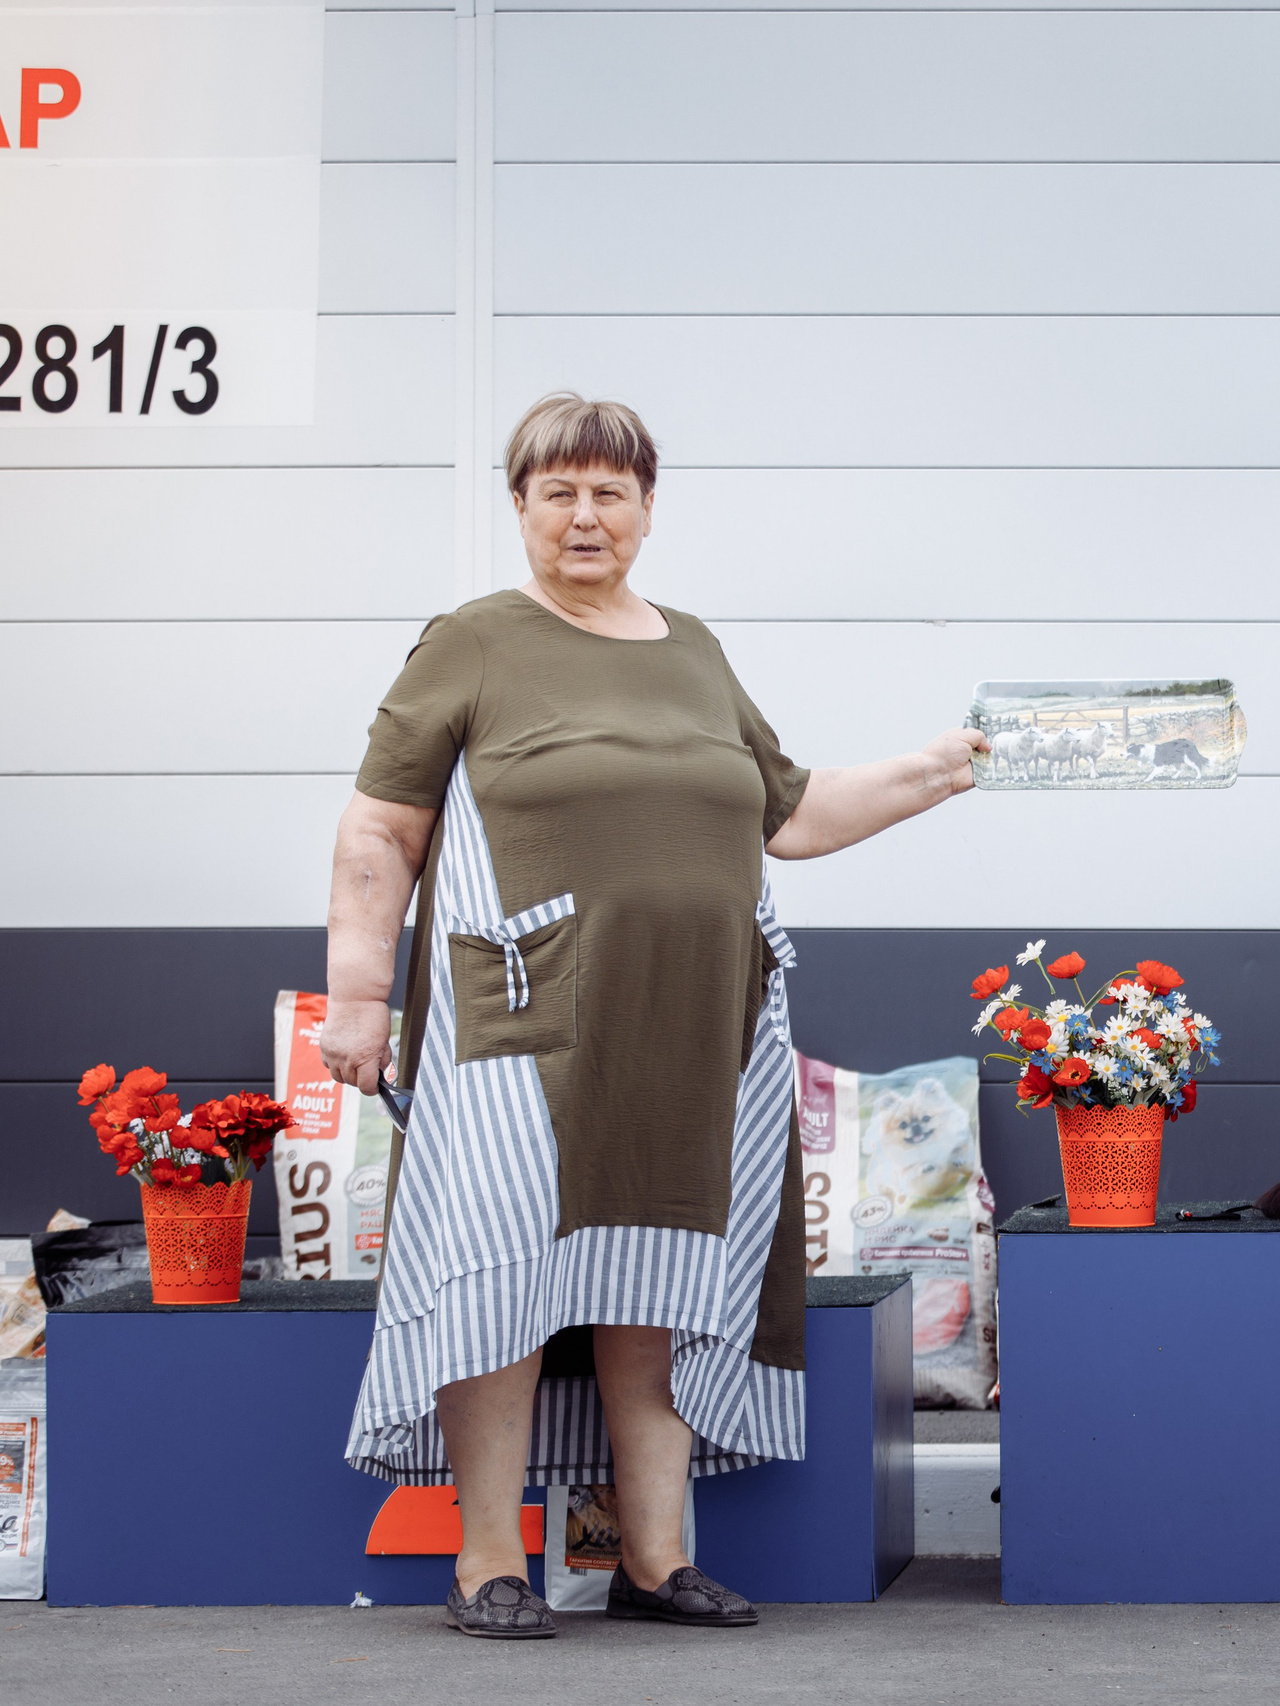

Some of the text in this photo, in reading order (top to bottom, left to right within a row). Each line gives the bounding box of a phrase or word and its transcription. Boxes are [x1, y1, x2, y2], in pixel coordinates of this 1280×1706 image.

[0, 67, 82, 149] Р
[292, 1095, 335, 1113] ADULT
[356, 1179, 386, 1191] 40%
